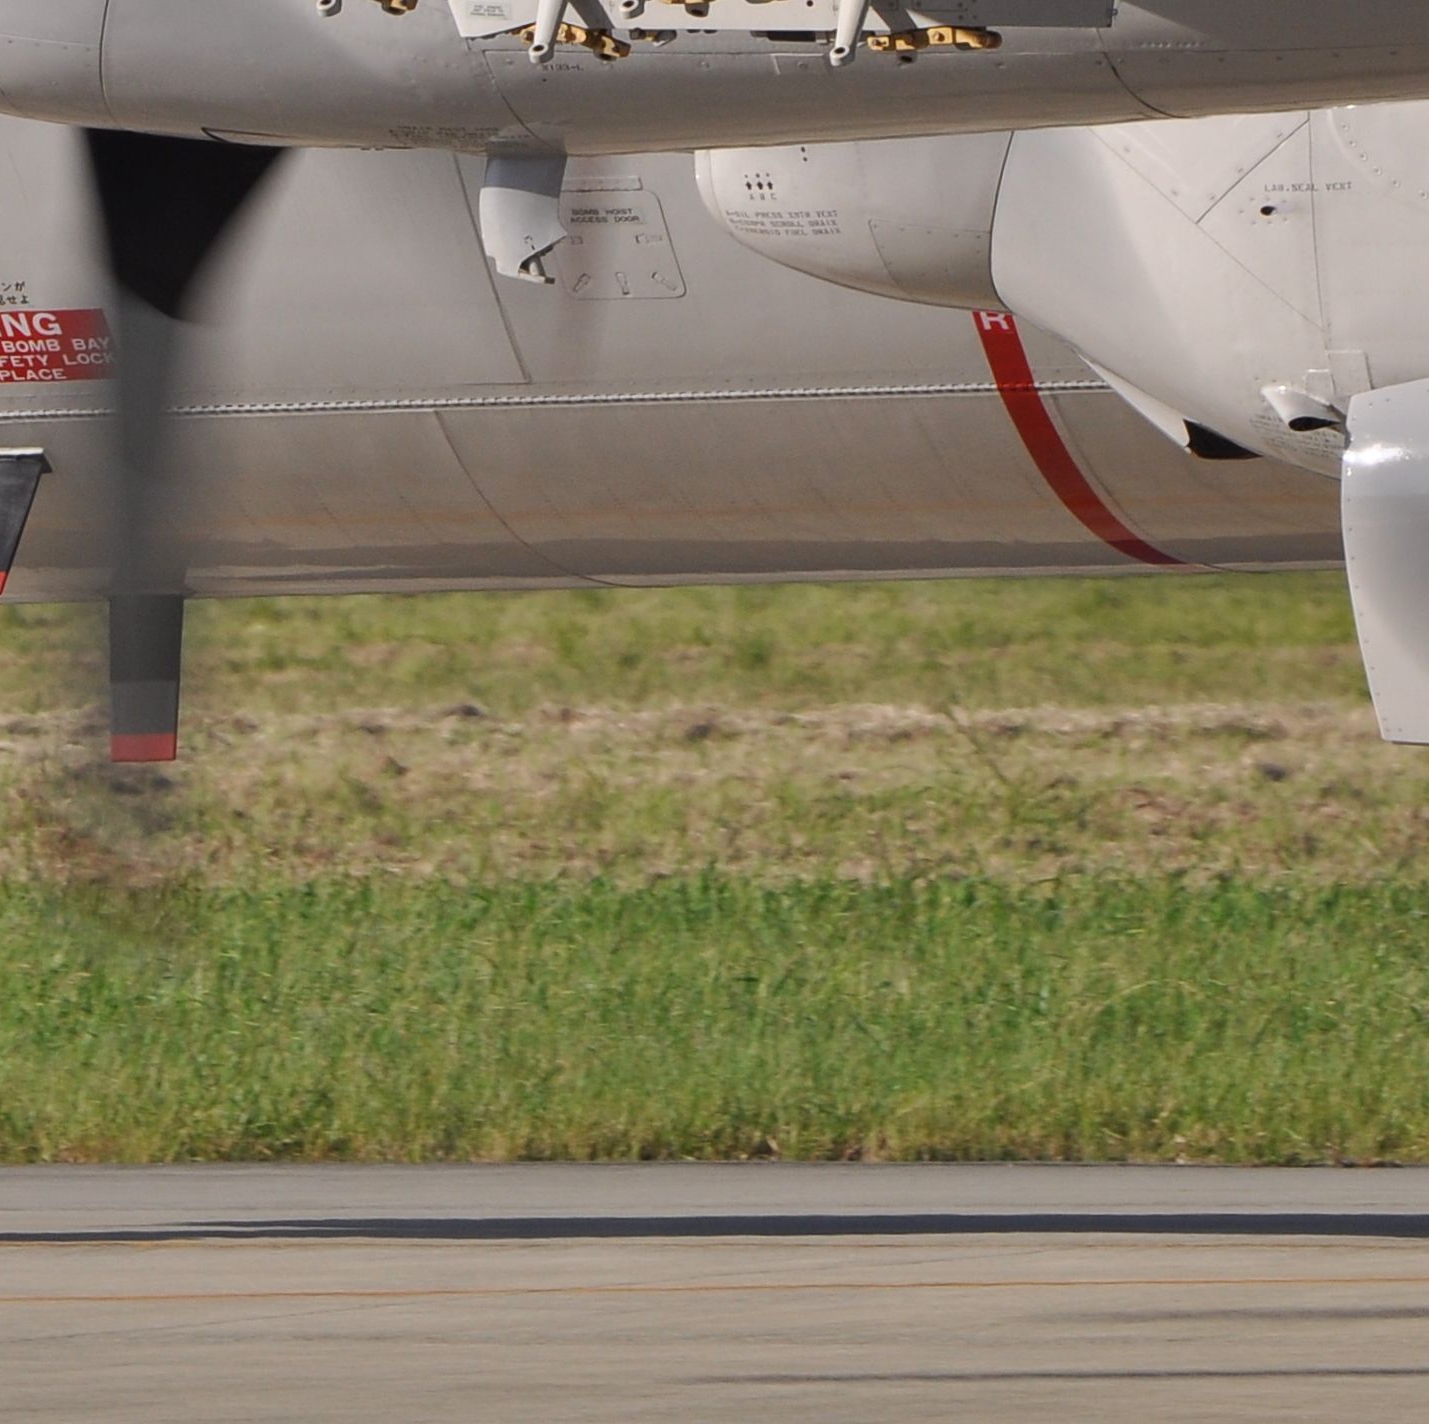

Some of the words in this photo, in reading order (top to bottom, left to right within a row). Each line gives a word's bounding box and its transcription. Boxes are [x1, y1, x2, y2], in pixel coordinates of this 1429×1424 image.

[570, 216, 608, 224] ACCESS
[2, 338, 61, 354] BOMB
[73, 336, 110, 351] BAY
[0, 367, 67, 381] PLACE
